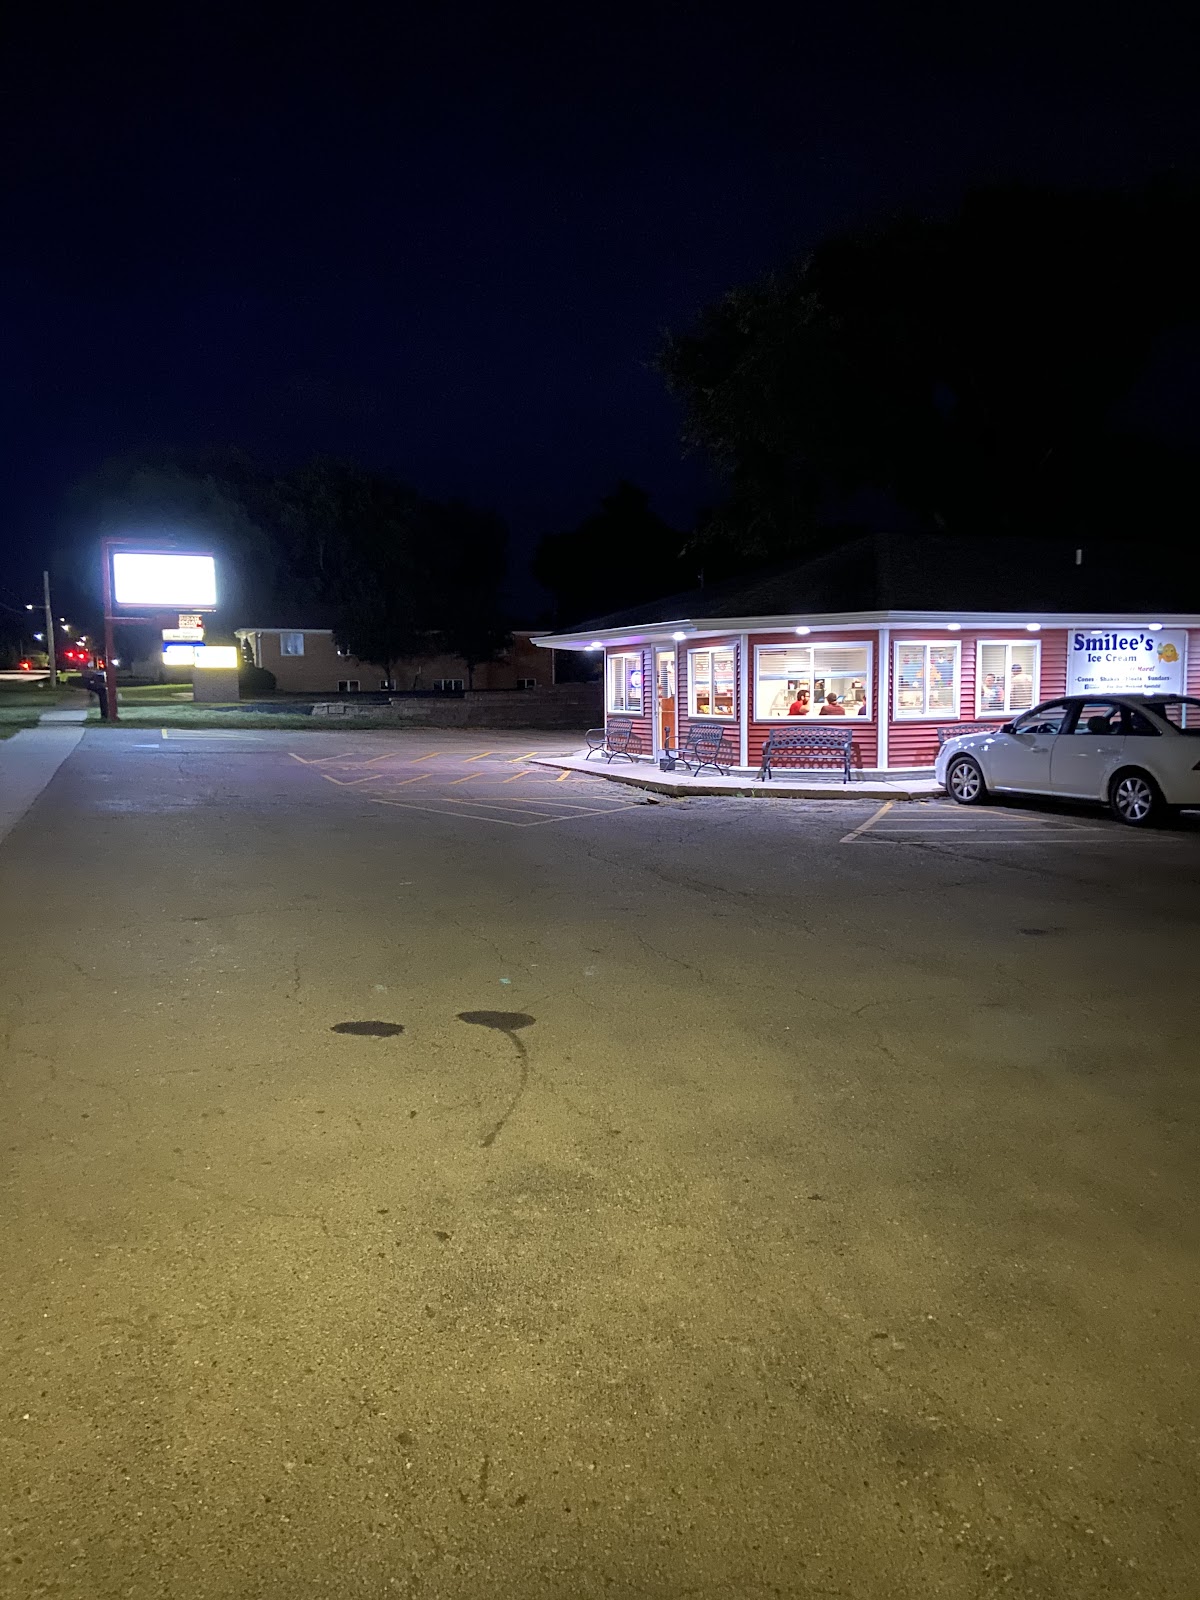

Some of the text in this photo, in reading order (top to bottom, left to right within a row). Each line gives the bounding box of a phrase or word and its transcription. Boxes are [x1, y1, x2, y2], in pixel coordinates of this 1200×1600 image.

[1073, 633, 1154, 651] Smilee's
[1087, 653, 1137, 663] Ice Cream
